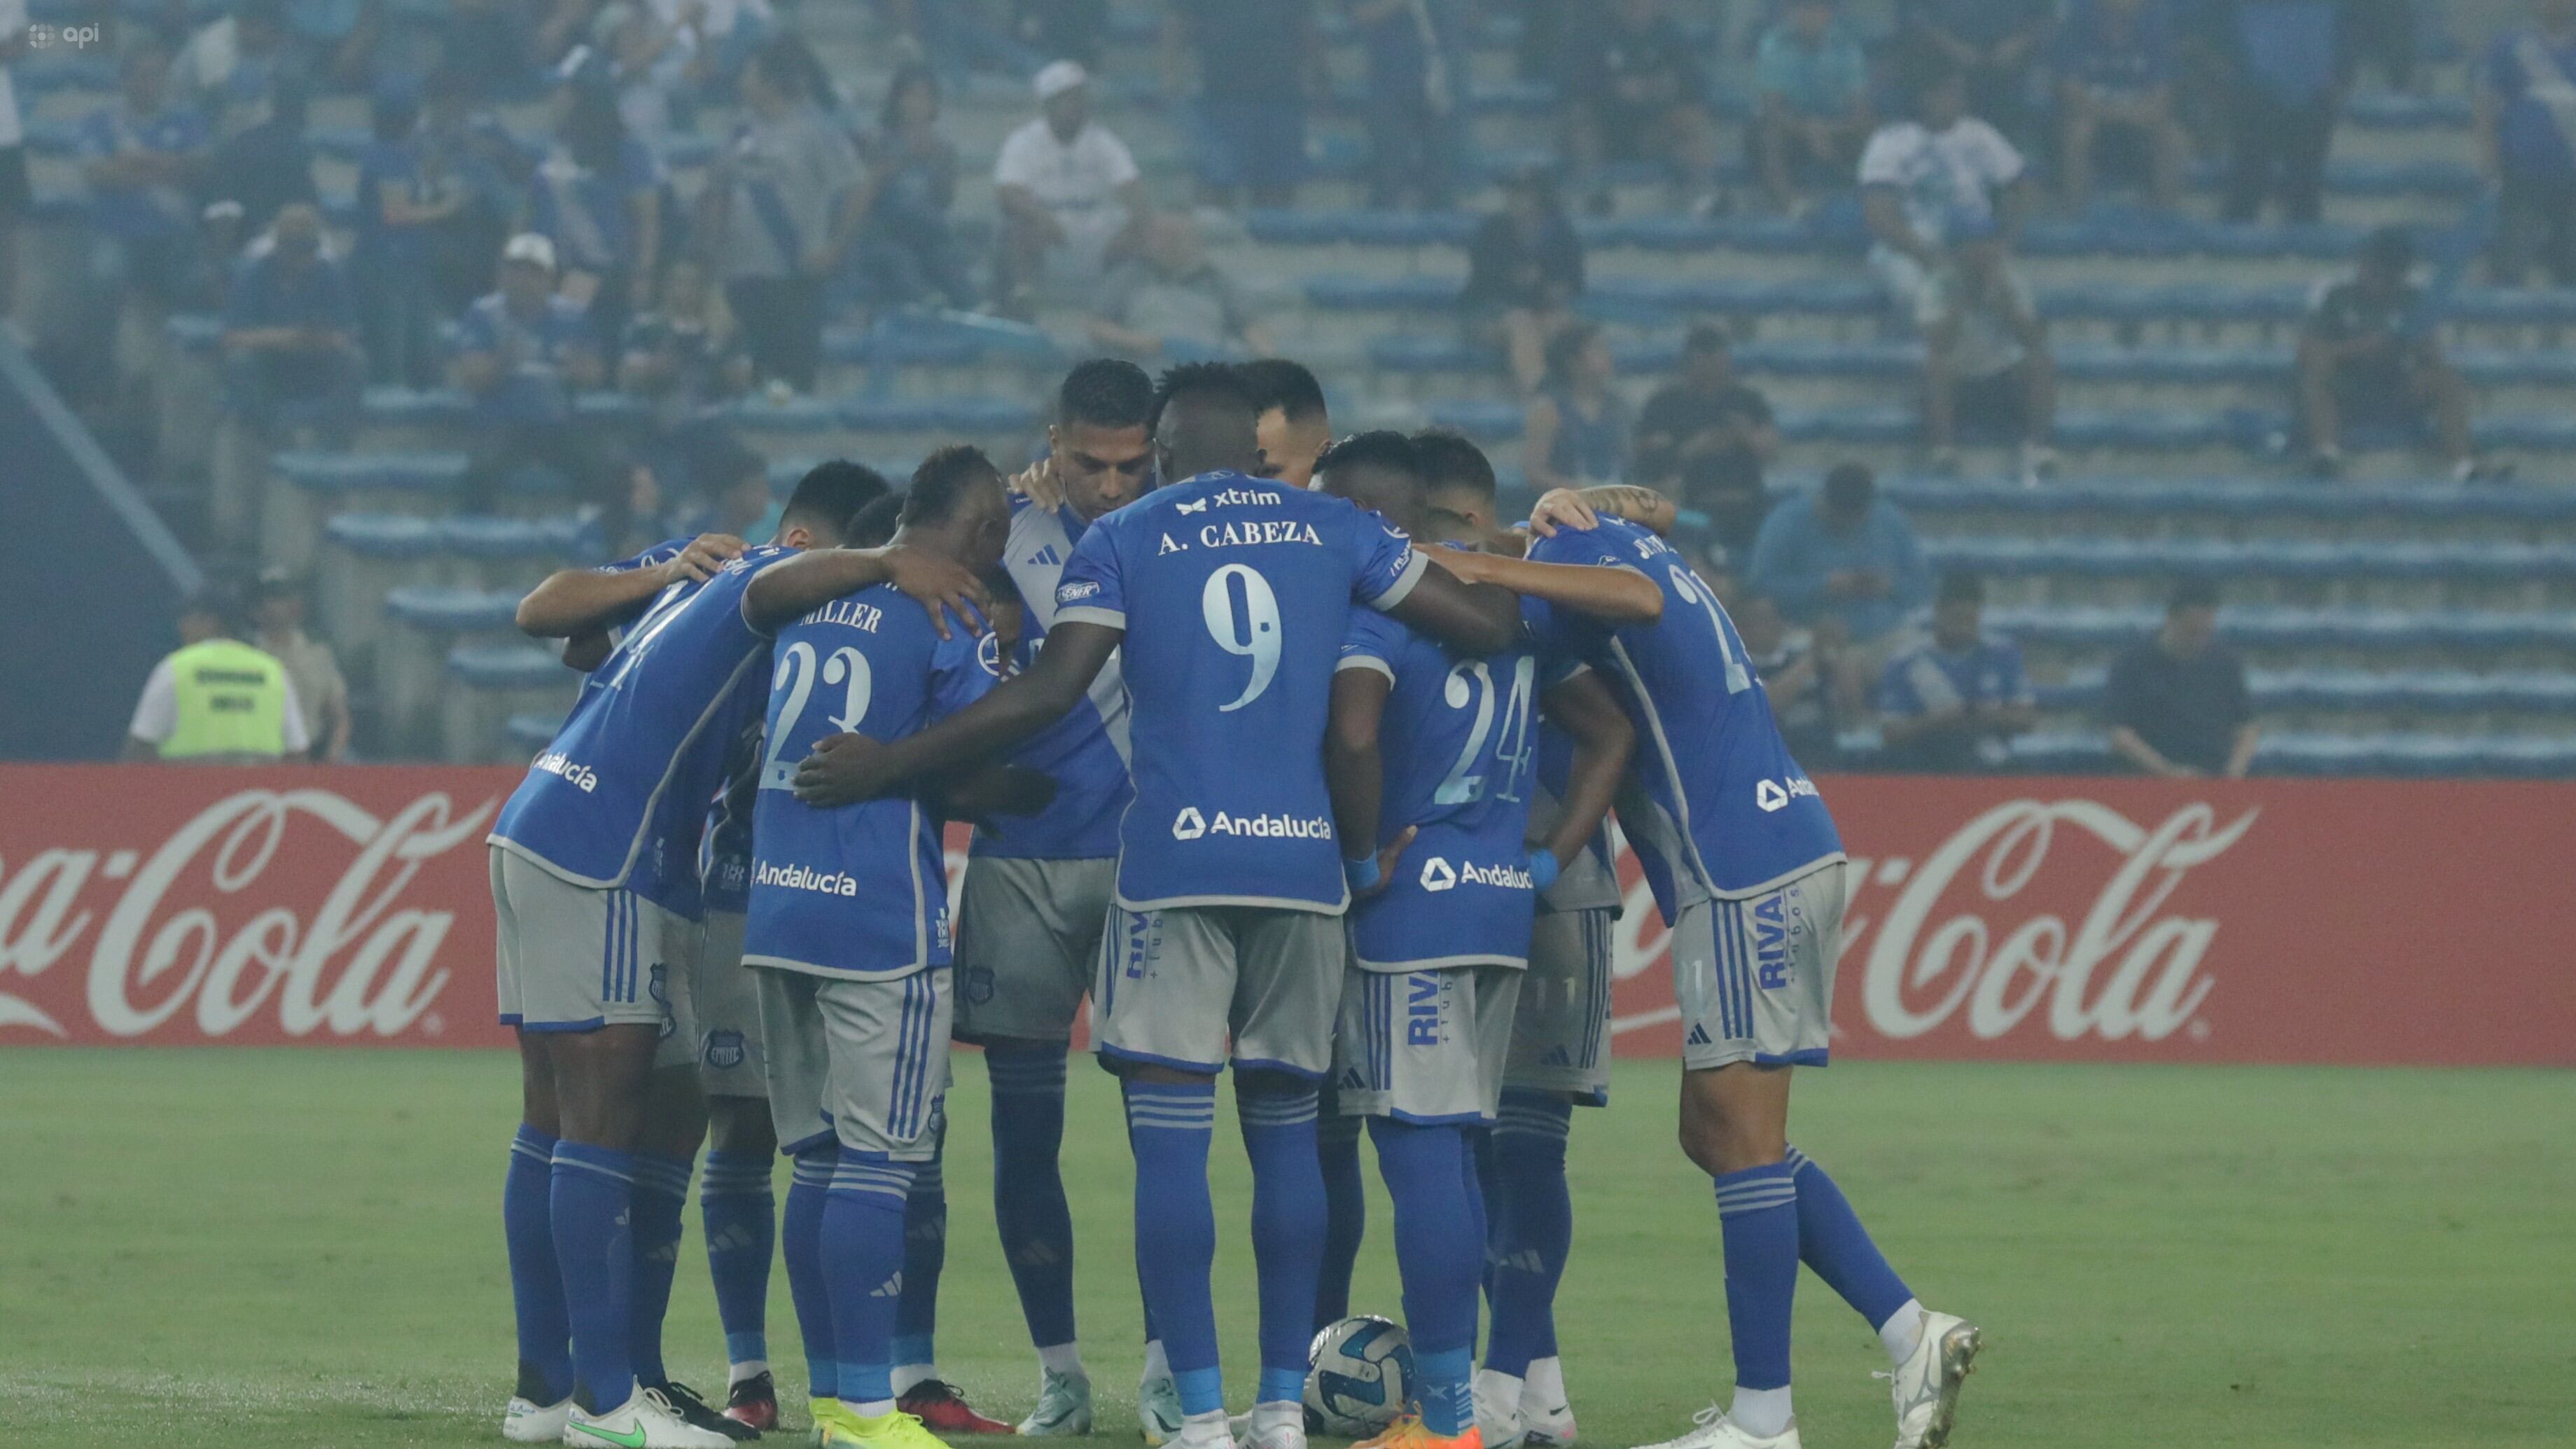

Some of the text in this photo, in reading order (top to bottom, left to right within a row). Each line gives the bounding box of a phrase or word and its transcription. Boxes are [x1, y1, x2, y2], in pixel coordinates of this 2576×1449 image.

[1157, 520, 1323, 556] A. CABEZA
[1213, 488, 1282, 508] xtrim
[1202, 562, 1283, 712] 9
[758, 641, 872, 791] 23
[1434, 655, 1536, 805] 24
[1210, 811, 1332, 840] Andalucía
[0, 789, 497, 1037] a-Cola
[756, 860, 857, 897] Andalucía
